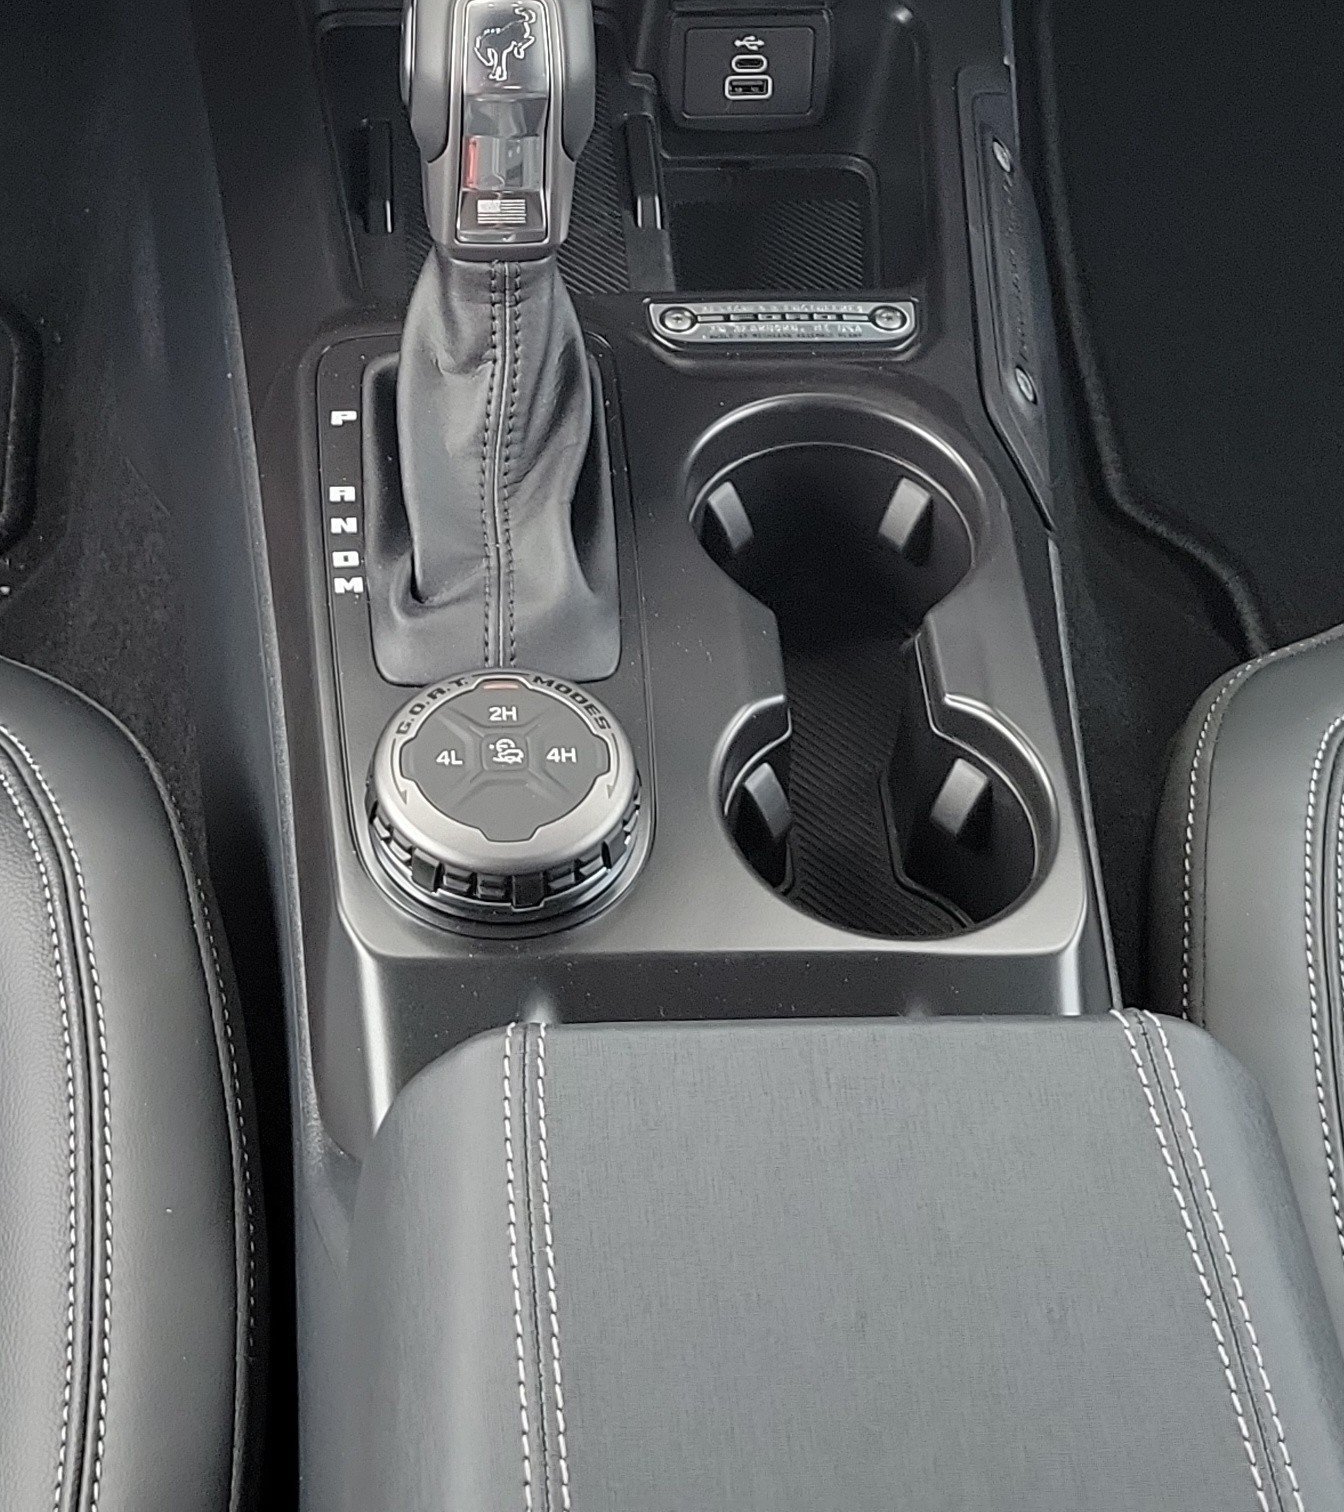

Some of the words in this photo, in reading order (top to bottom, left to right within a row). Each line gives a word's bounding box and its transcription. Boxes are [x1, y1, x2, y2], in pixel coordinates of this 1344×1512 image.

[330, 409, 357, 426] P
[330, 516, 358, 534] N
[332, 551, 360, 568] D
[333, 576, 364, 594] M
[395, 675, 469, 735] G.O.A.T.
[532, 675, 612, 731] MODES
[489, 706, 518, 722] 2H
[435, 749, 464, 766] 4L
[546, 747, 577, 764] 4H
